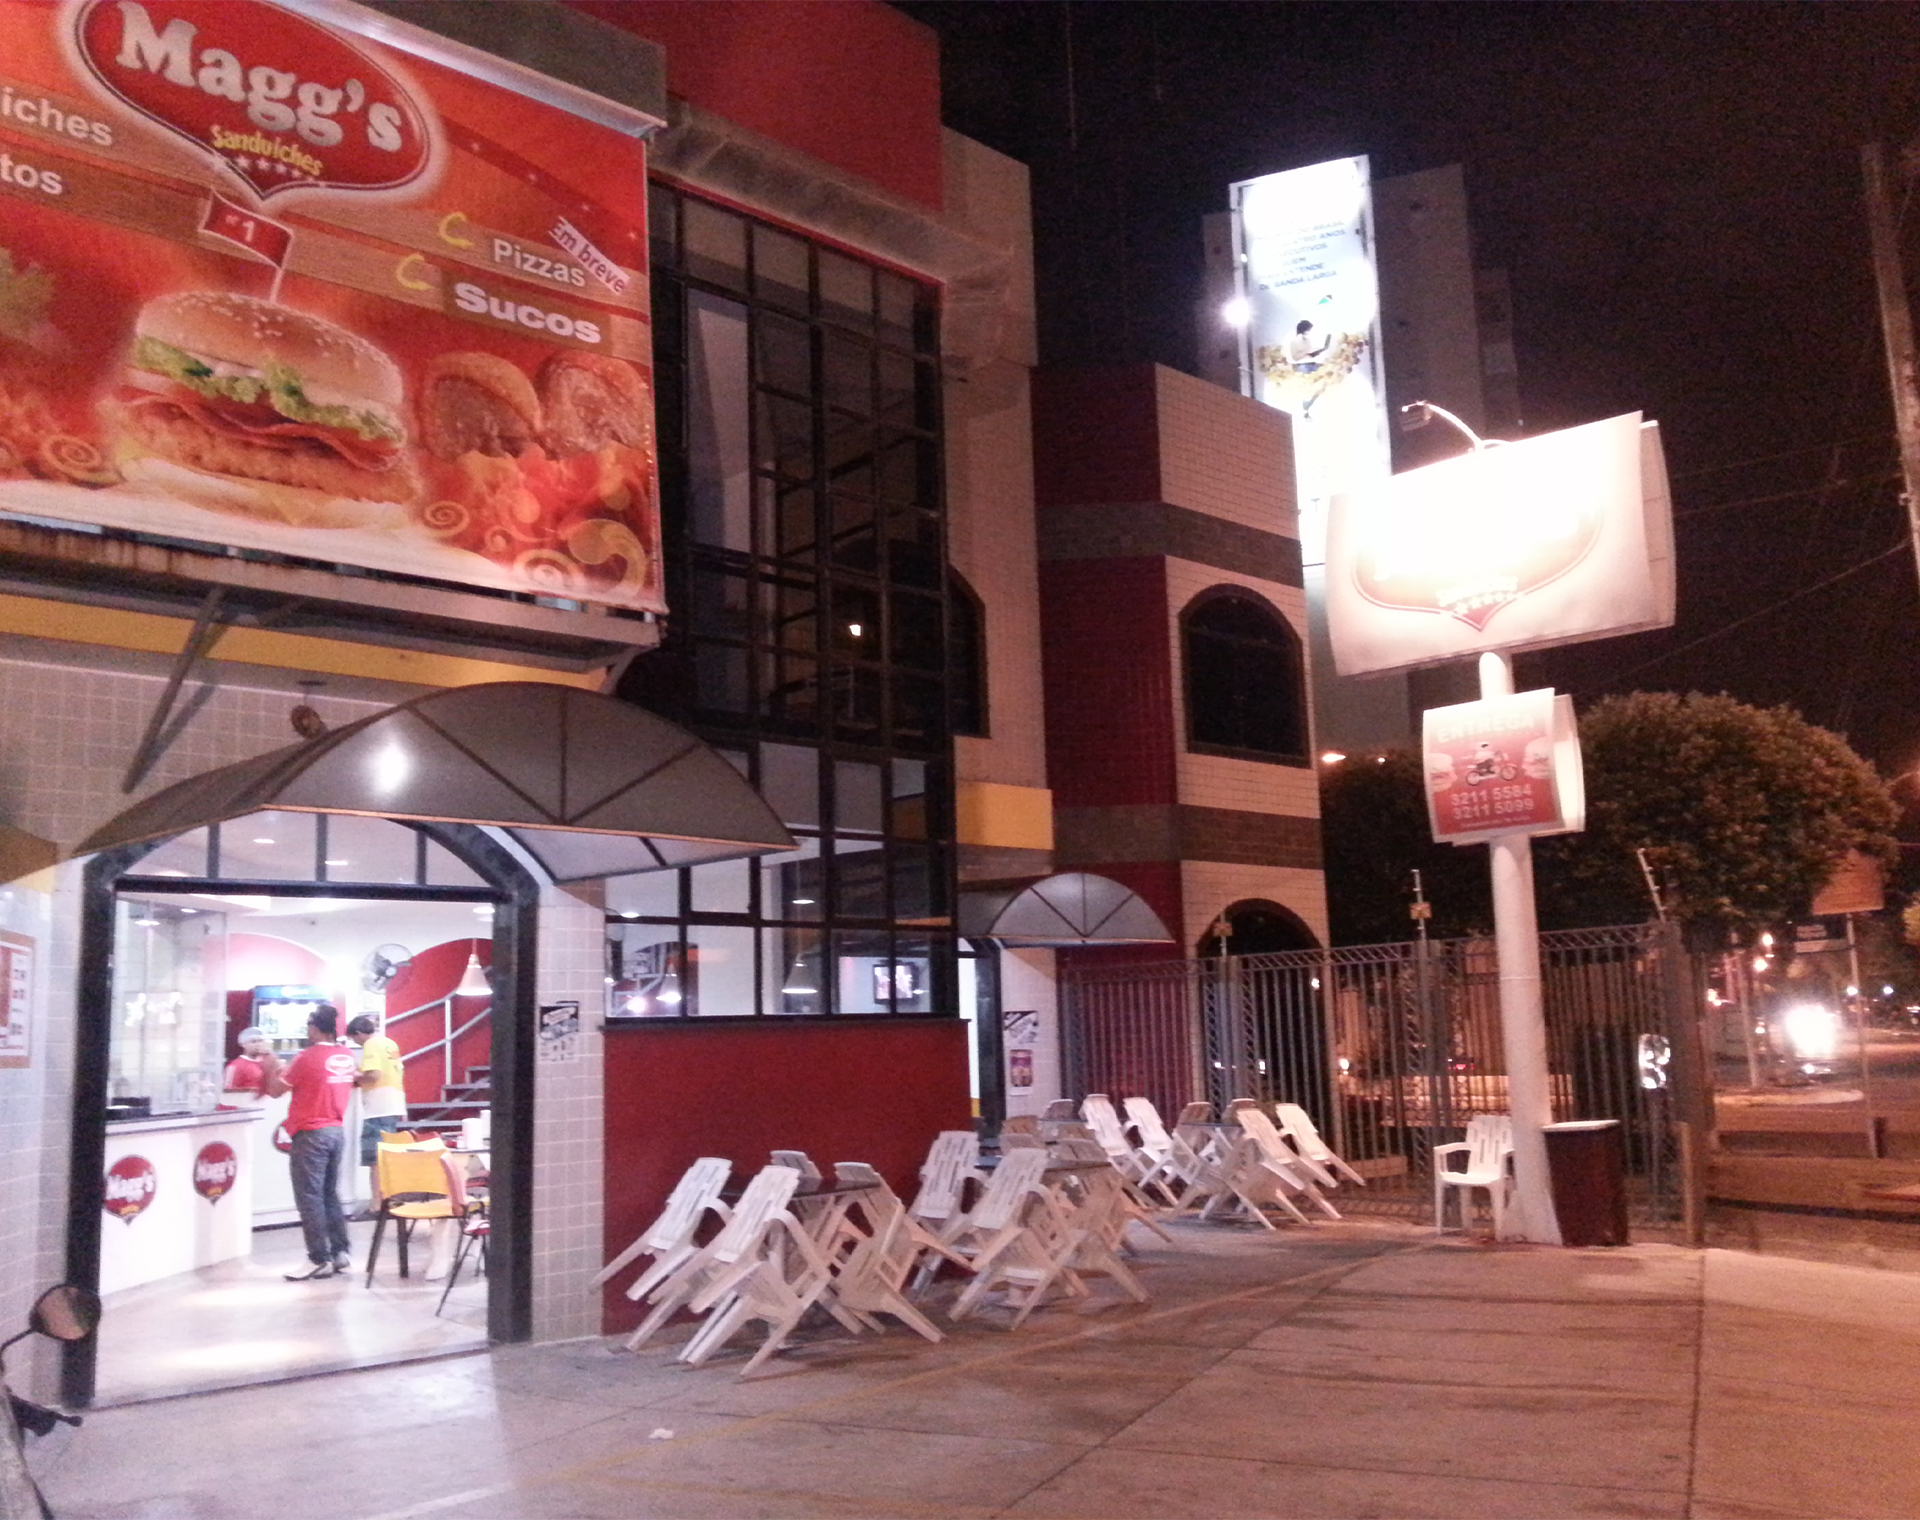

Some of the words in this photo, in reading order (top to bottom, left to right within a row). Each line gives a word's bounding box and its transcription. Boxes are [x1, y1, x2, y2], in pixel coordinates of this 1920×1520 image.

[114, 0, 402, 153] Magg's
[493, 238, 586, 288] Pizzas
[578, 243, 625, 293] breve
[454, 281, 602, 344] Sucos
[1438, 712, 1535, 743] ENTREGA
